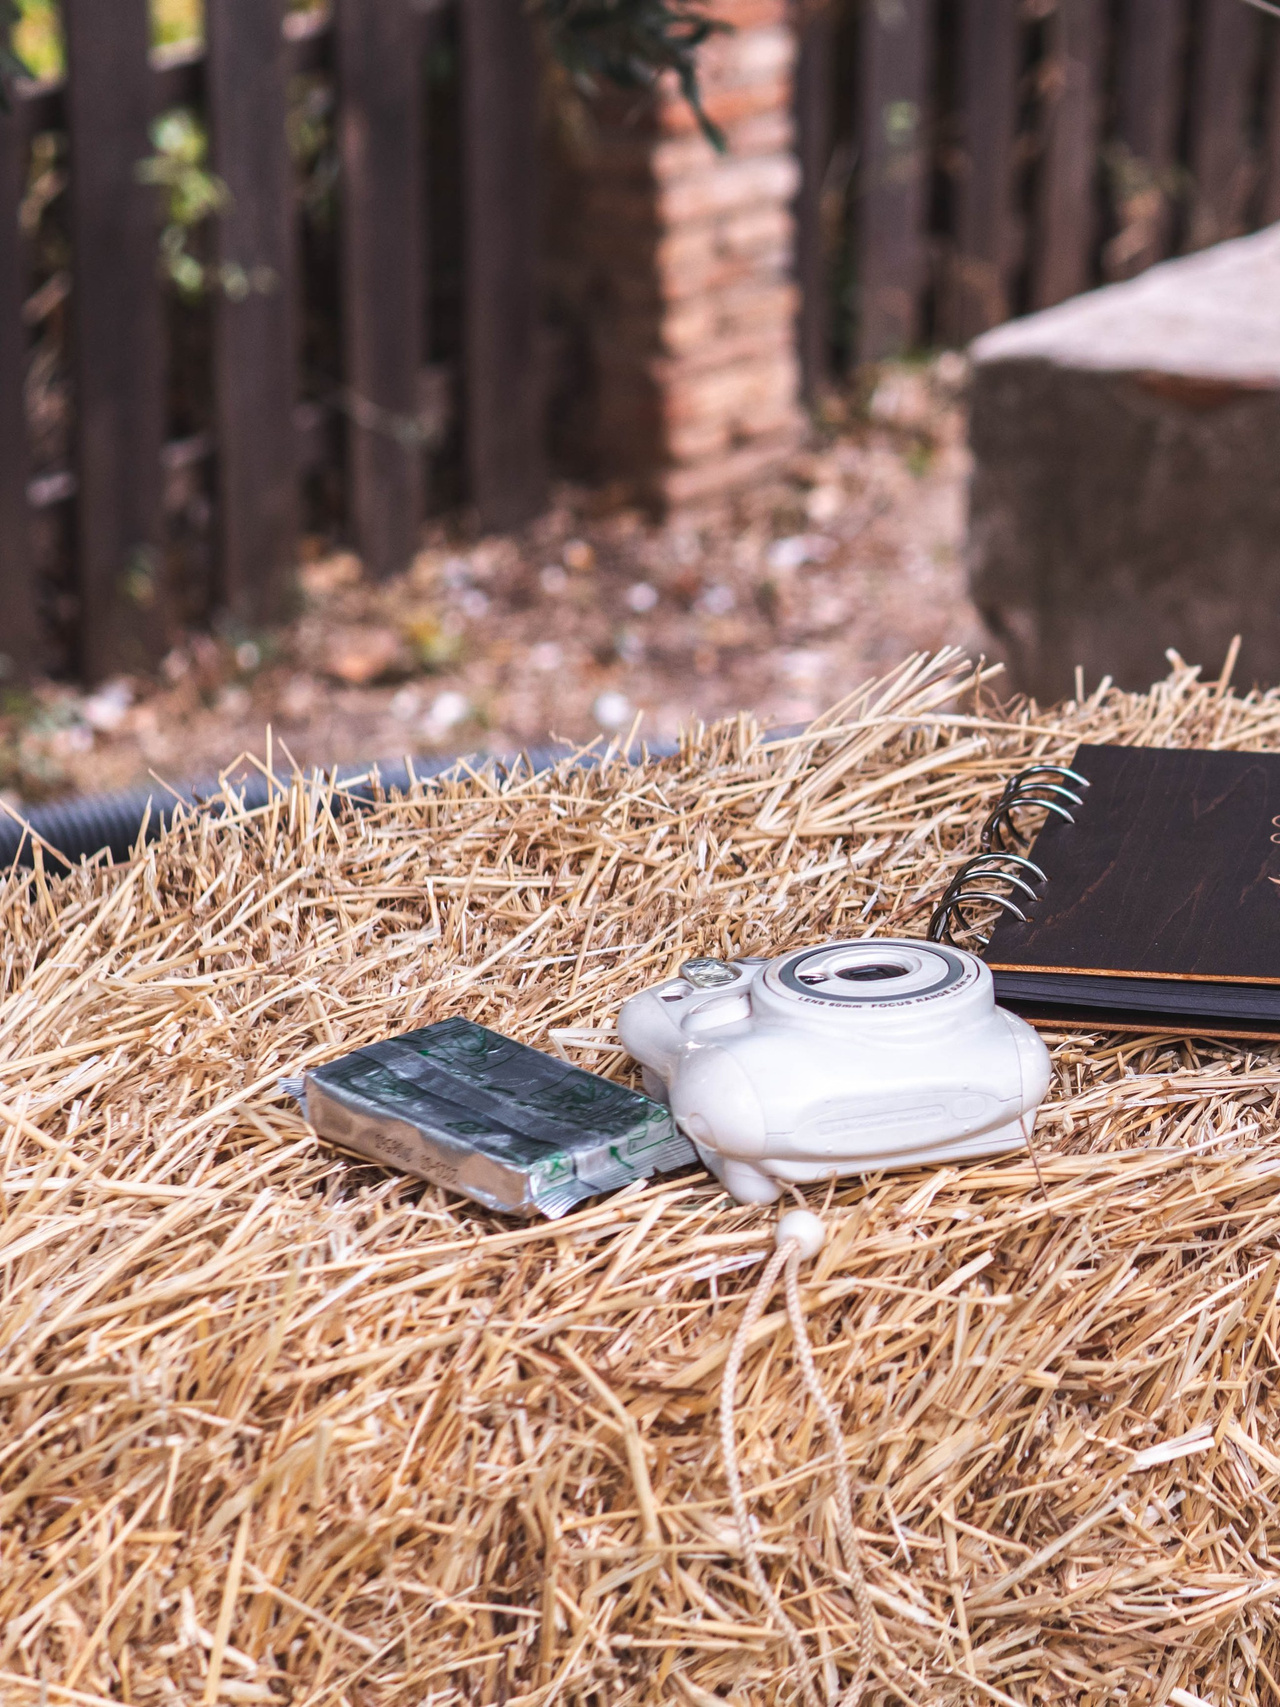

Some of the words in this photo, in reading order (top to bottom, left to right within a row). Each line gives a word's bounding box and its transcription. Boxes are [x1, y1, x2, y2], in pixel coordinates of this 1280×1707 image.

[798, 996, 826, 1006] LENS
[871, 1000, 912, 1009] FOCUS
[916, 989, 951, 1003] RANGE
